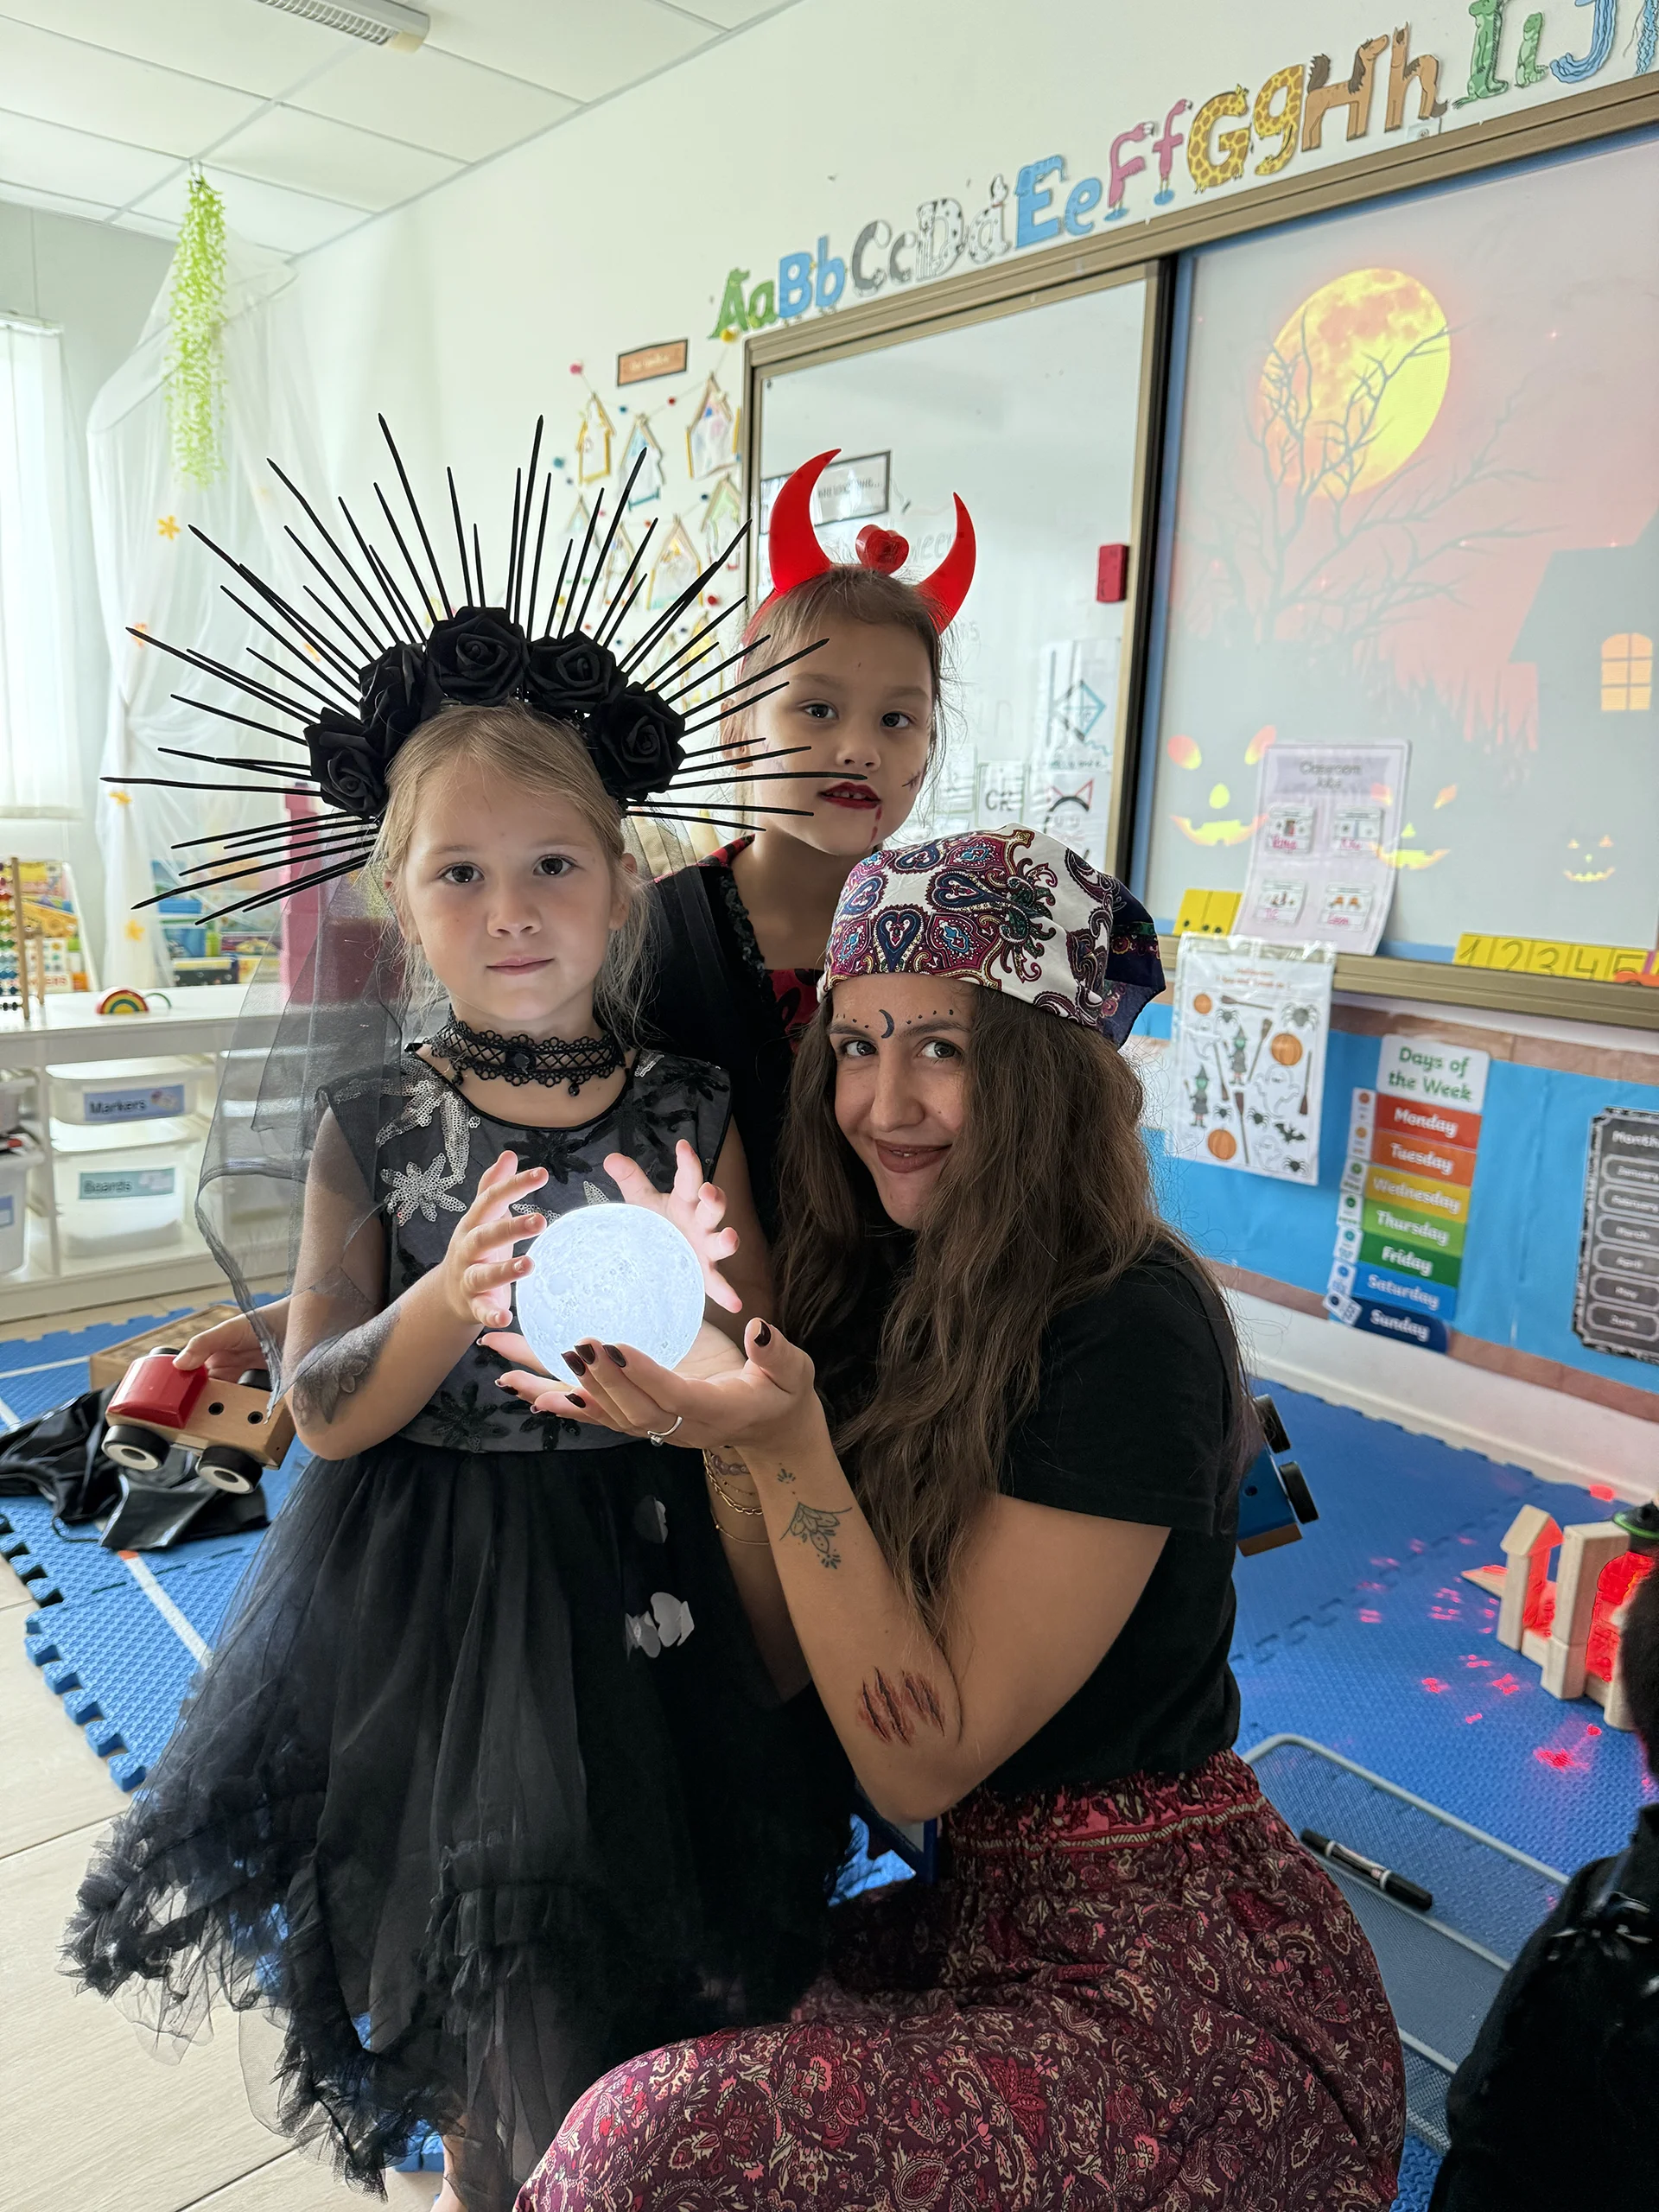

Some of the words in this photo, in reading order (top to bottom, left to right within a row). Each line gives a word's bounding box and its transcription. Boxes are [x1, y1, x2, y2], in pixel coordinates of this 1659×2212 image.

[708, 267, 779, 340] Aa
[778, 236, 847, 326] Bb
[850, 220, 917, 297] Cc
[916, 175, 1012, 282] Dd
[1014, 154, 1103, 250] Ee
[1103, 98, 1193, 222] Ff
[1186, 64, 1305, 194] Gg
[1300, 22, 1448, 153] Hh
[1398, 1046, 1444, 1073] Days
[1450, 1056, 1471, 1077] of
[1389, 1070, 1417, 1091] the
[1422, 1076, 1473, 1102] Week
[89, 1098, 147, 1115] Markers
[1394, 1107, 1459, 1139] Monday
[1389, 1141, 1455, 1176] Tuesday
[1372, 1176, 1462, 1215] Wednesday
[1376, 1210, 1450, 1247] Thursday
[1381, 1245, 1433, 1278] Friday
[1367, 1273, 1440, 1312] Saturday
[1370, 1308, 1431, 1343] Sunday
